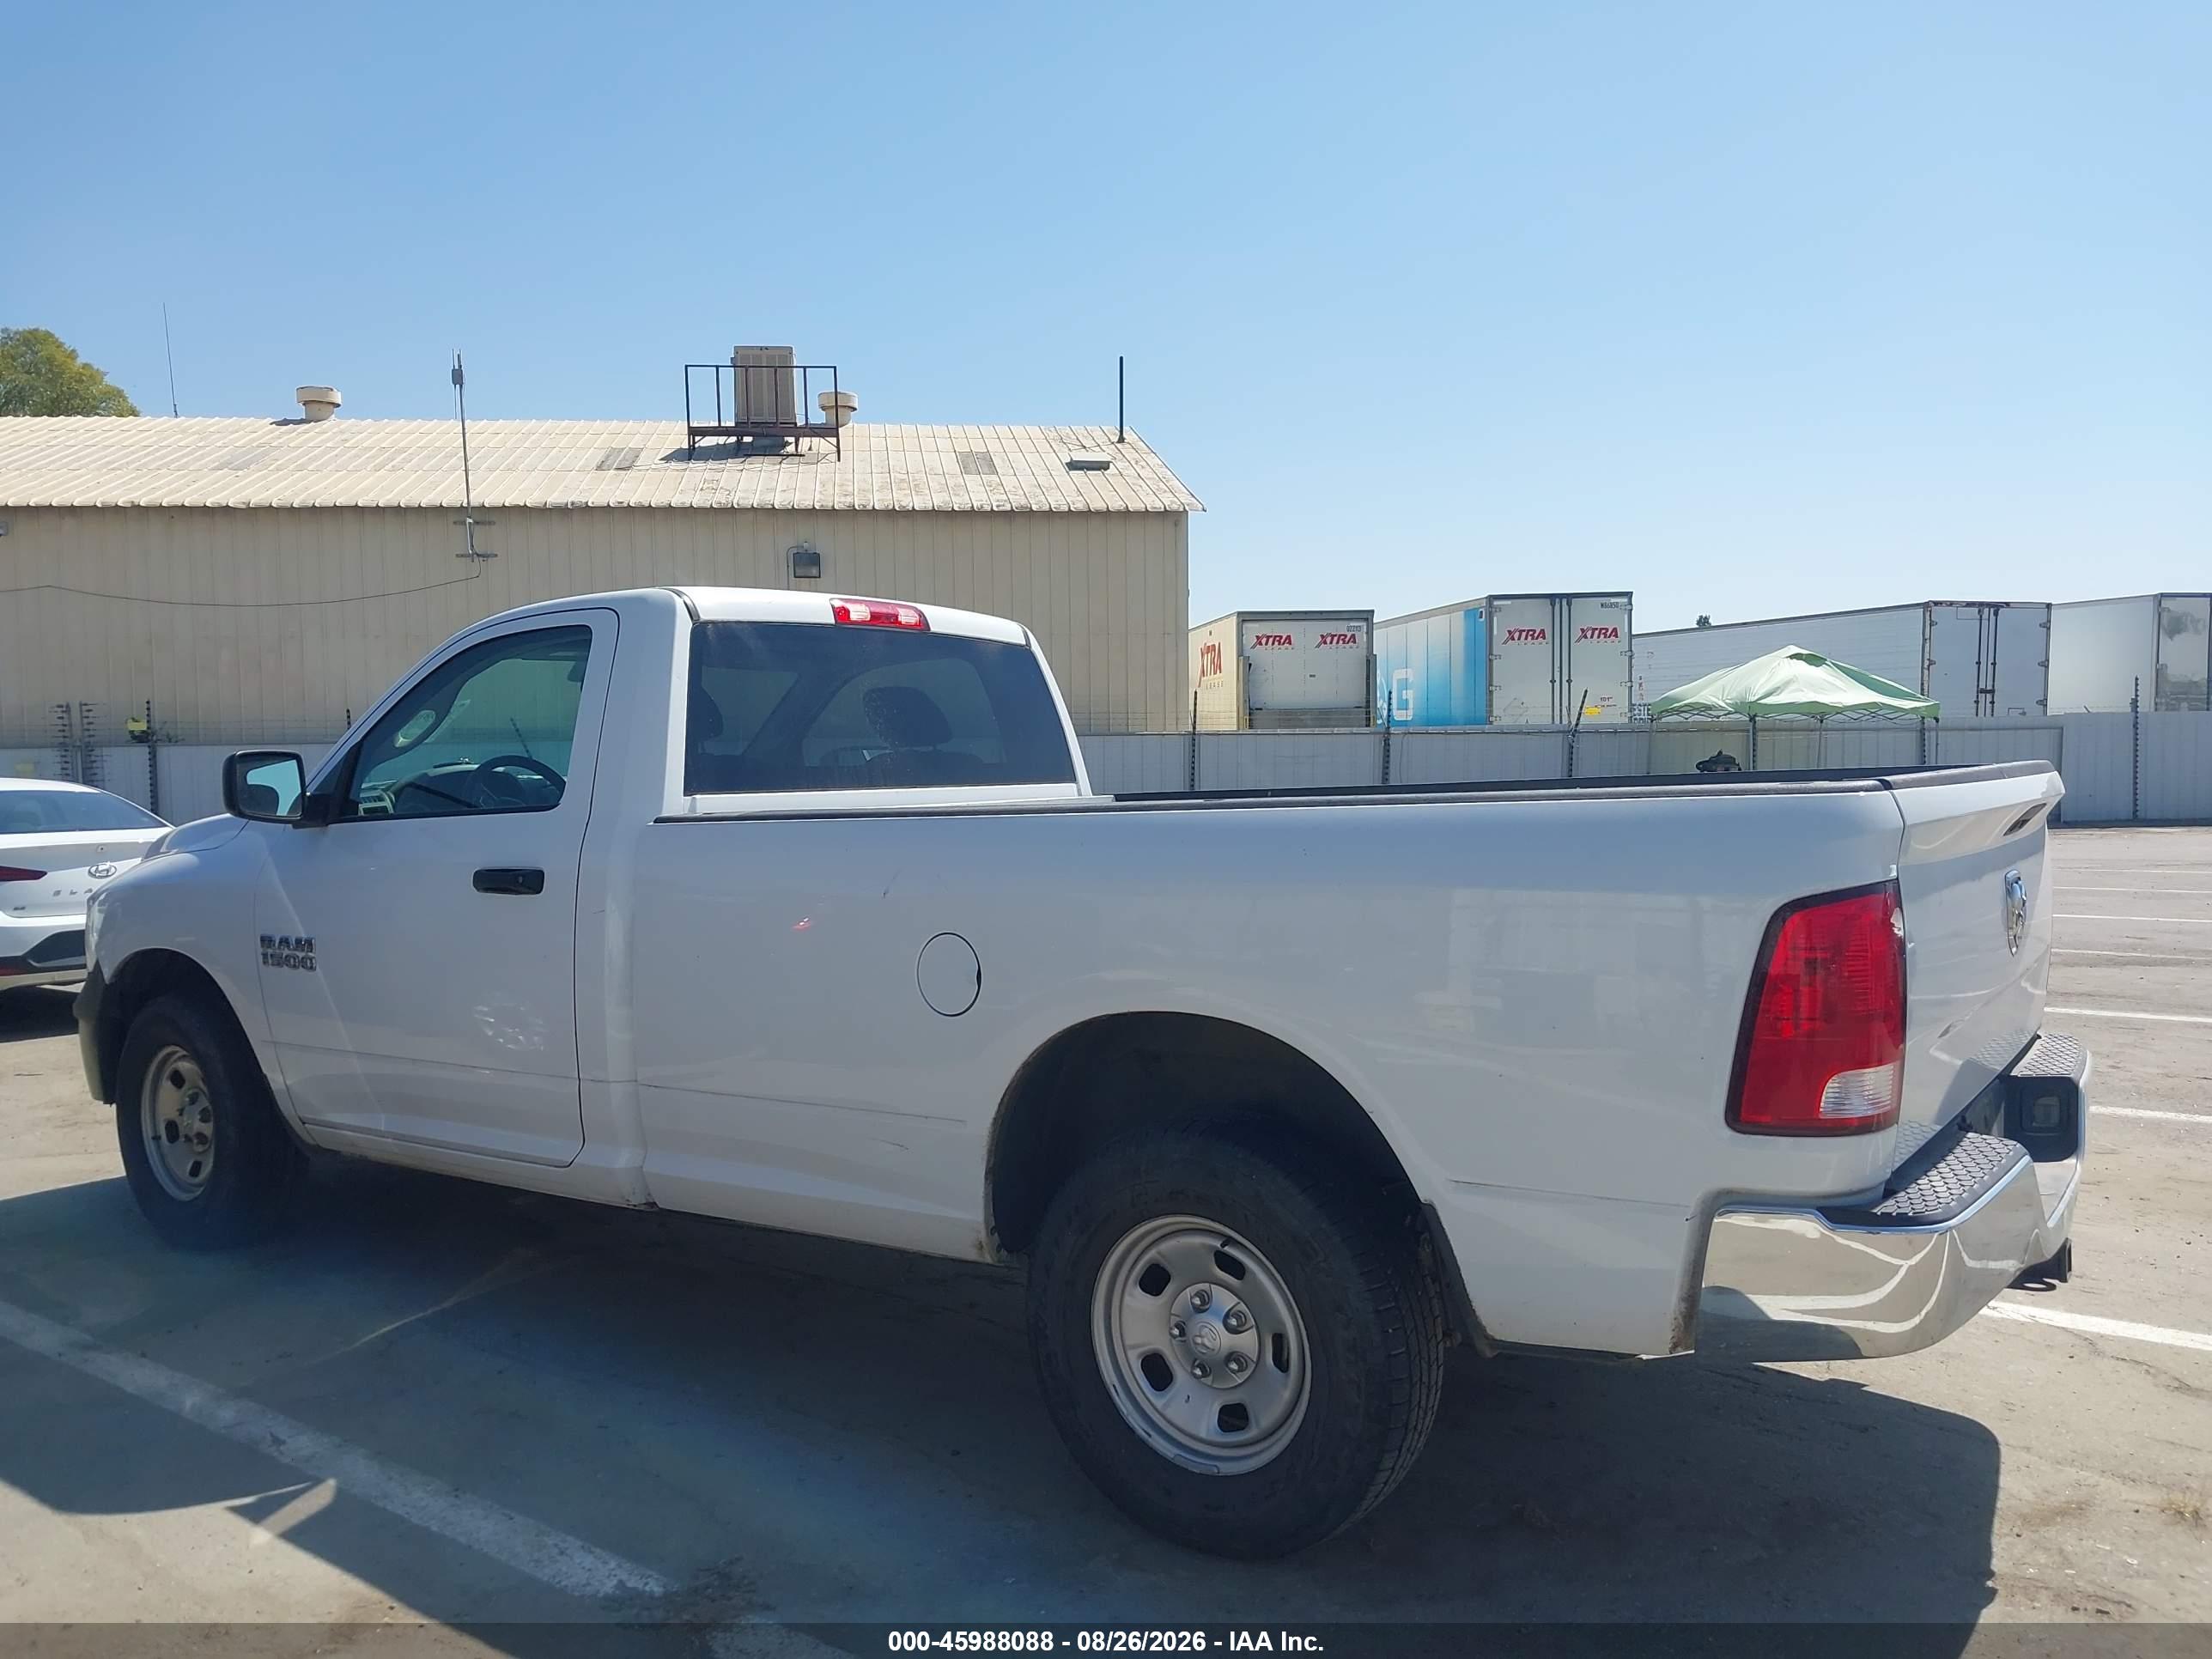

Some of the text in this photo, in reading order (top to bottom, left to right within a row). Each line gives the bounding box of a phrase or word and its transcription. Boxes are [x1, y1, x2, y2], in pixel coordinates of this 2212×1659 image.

[1250, 633, 1293, 650] XTRA
[1315, 632, 1357, 649] XTRA
[1502, 628, 1547, 645] XTRA
[1574, 626, 1620, 644] XTRA
[1197, 641, 1222, 688] XTRA
[259, 934, 316, 954] RAM
[260, 951, 317, 972] 1500
